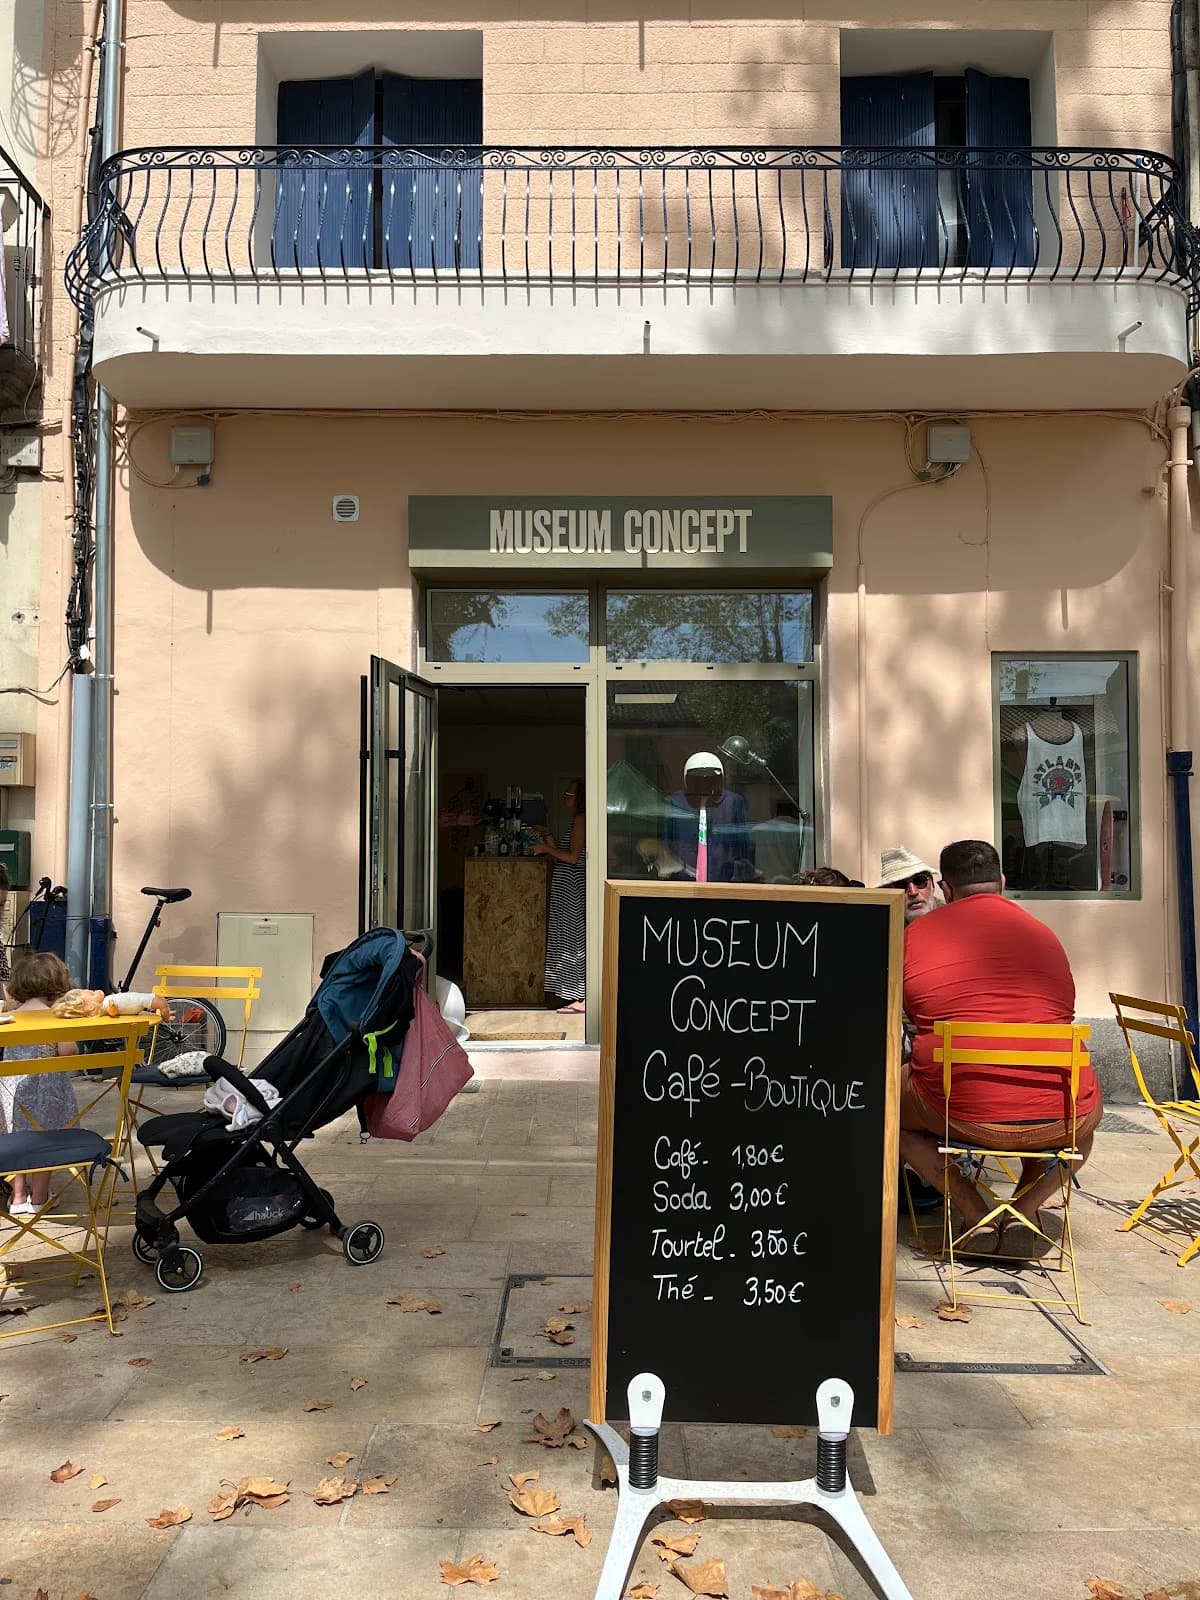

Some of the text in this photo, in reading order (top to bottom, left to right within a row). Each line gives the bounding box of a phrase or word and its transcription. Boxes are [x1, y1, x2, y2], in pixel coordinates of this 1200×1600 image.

[489, 509, 753, 554] MUSEUM CONCEPT
[642, 915, 819, 977] MUSEUM
[670, 974, 817, 1047] CONCEPT
[642, 1049, 721, 1118] Café
[731, 1144, 785, 1169] 1,80€
[652, 1180, 712, 1213] Soda
[652, 1273, 699, 1301] Thé
